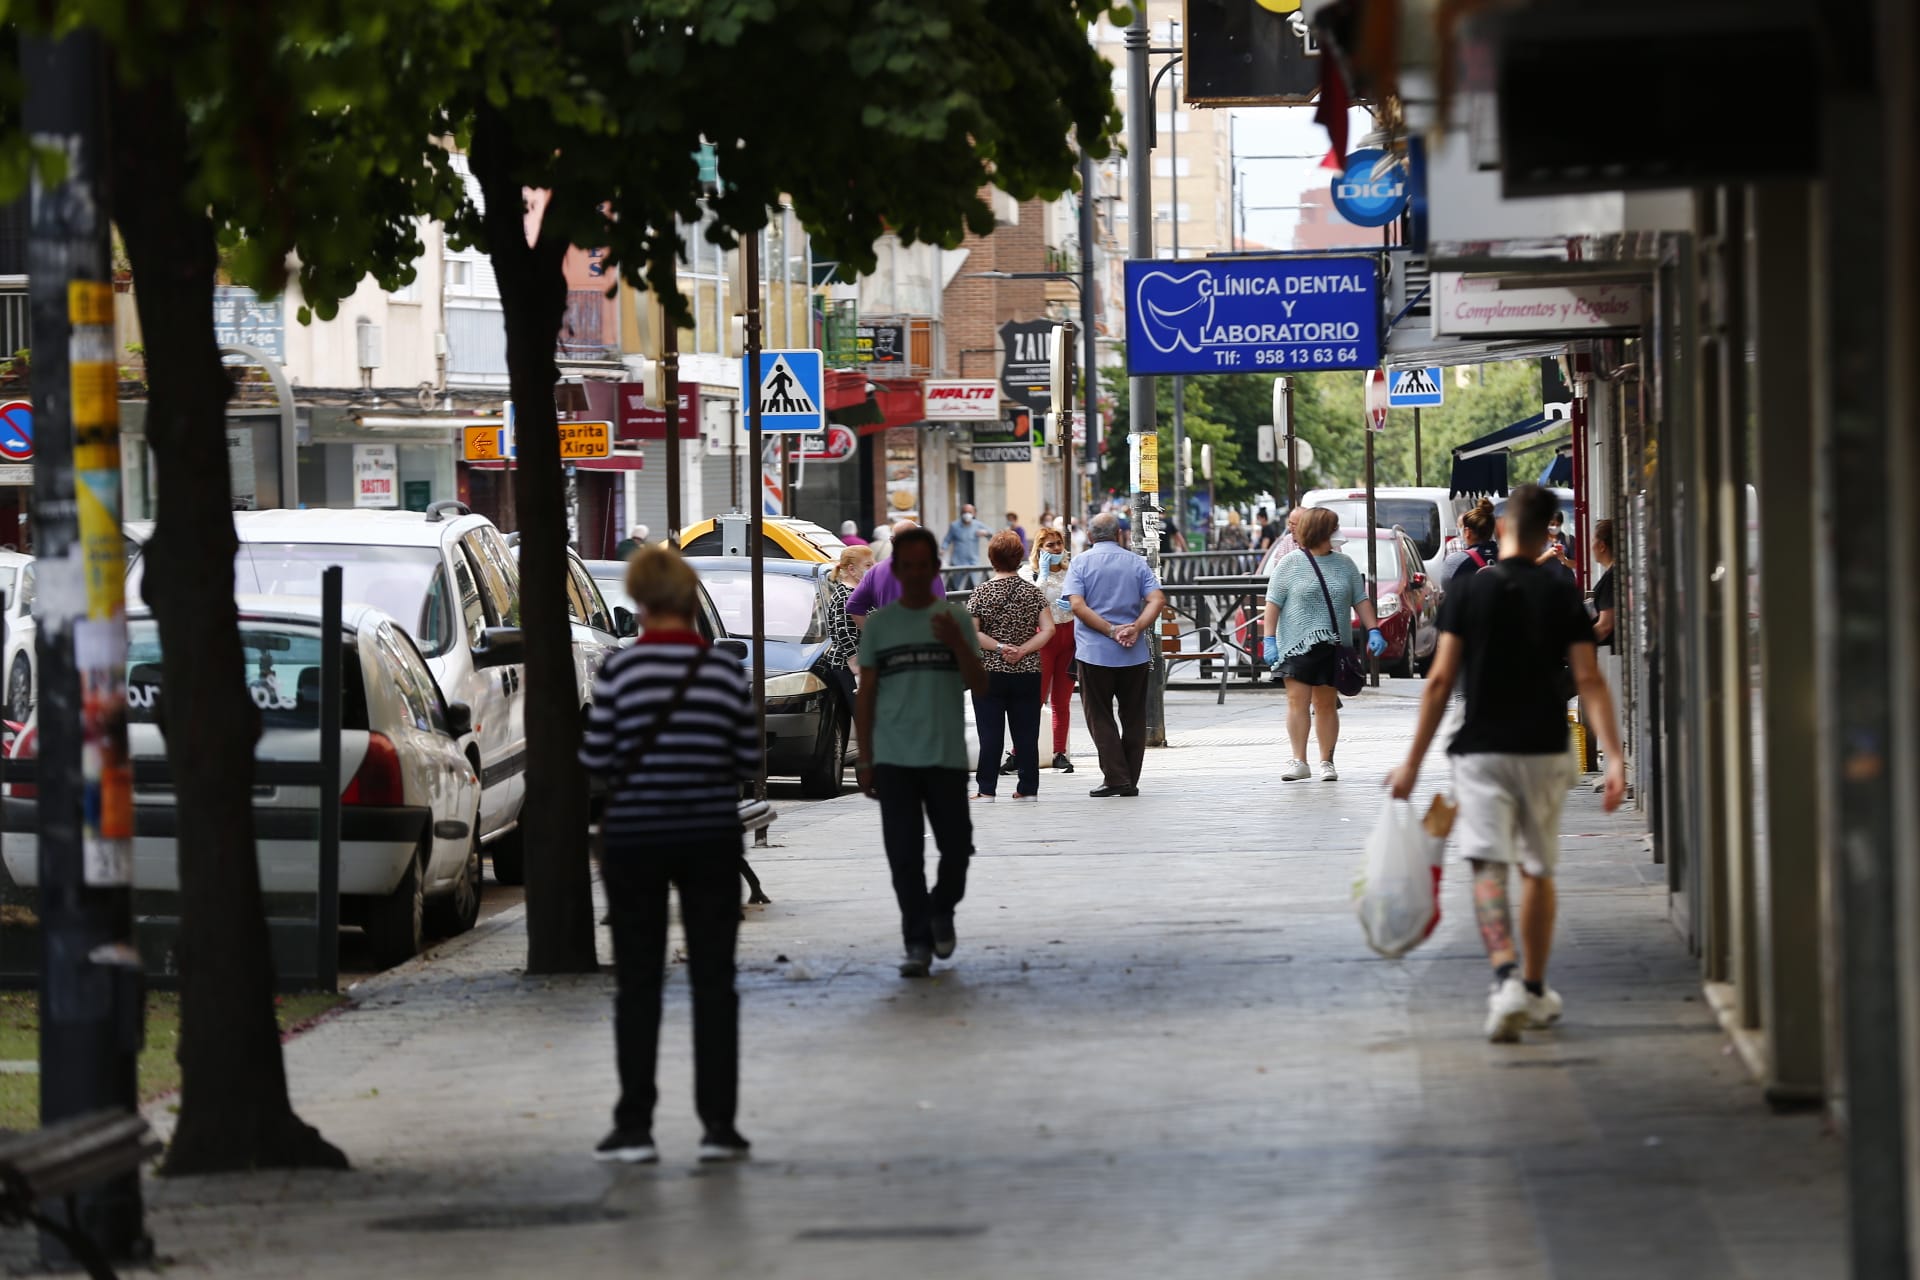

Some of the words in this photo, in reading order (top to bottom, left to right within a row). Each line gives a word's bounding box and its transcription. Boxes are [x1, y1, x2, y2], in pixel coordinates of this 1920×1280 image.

[1337, 182, 1404, 199] DIGI
[1198, 275, 1281, 297] CLÍNICA
[1285, 275, 1367, 295] DENTAL
[1281, 300, 1297, 318] Y
[1455, 301, 1556, 325] Complementos
[1561, 303, 1572, 323] y
[1573, 297, 1630, 324] Regalos
[1200, 322, 1360, 343] LABORATORIO
[1214, 351, 1241, 365] Tlf:
[1255, 349, 1285, 364] 958
[1290, 349, 1309, 363] 13
[1313, 348, 1333, 363] 63
[1337, 348, 1358, 362] 64
[928, 388, 994, 399] IMPACTO
[559, 426, 604, 440] garita
[564, 442, 604, 455] Xirgu
[361, 479, 391, 493] RASTRO
